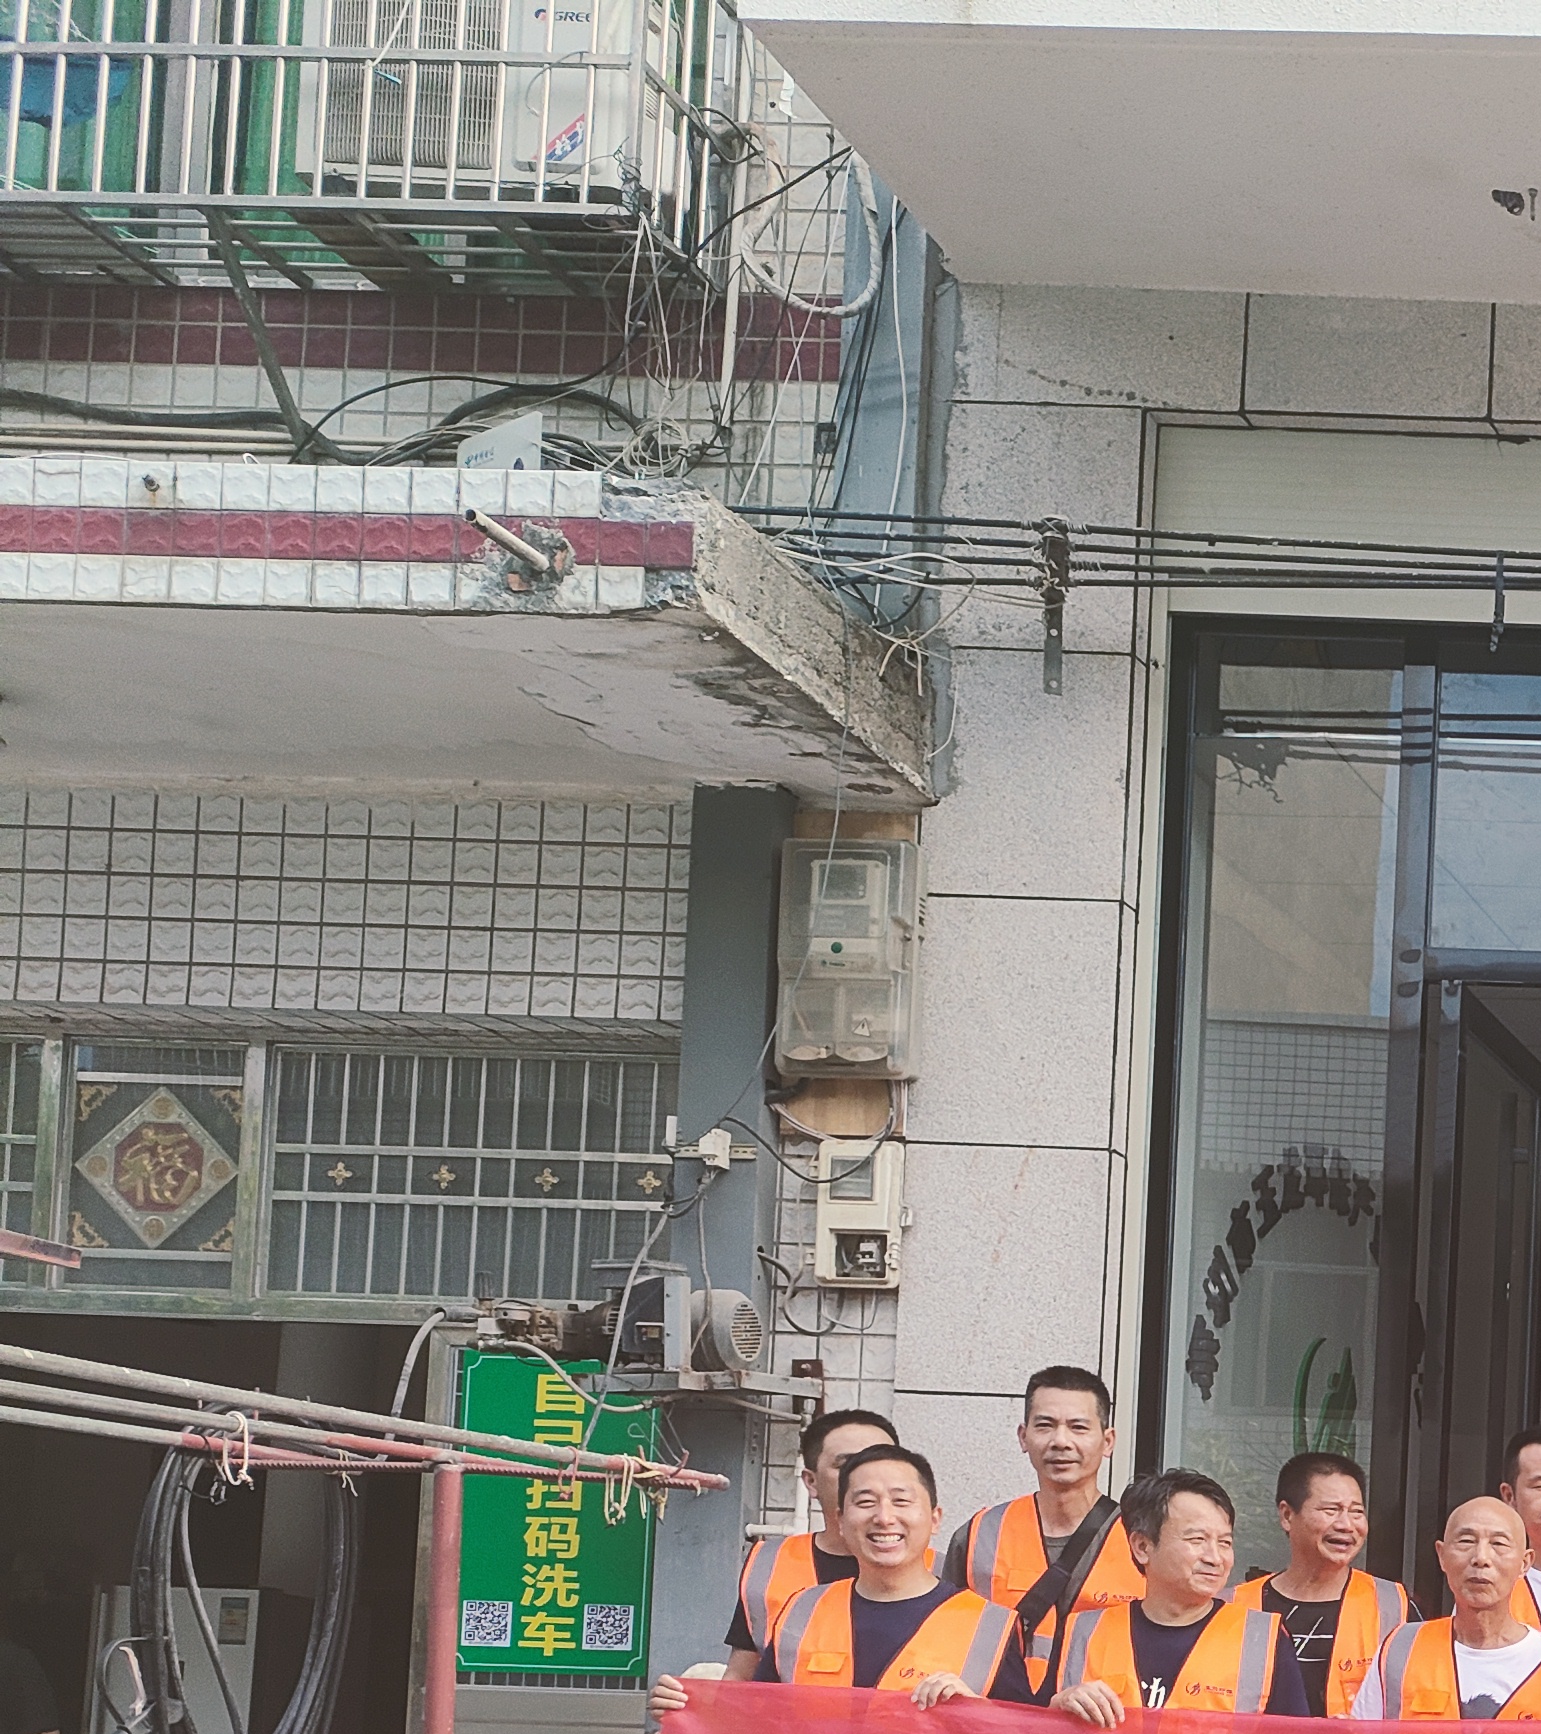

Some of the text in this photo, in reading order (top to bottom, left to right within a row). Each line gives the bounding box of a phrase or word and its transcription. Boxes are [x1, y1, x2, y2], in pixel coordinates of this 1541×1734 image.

[518, 1372, 585, 1656] 自己扫码洗车
